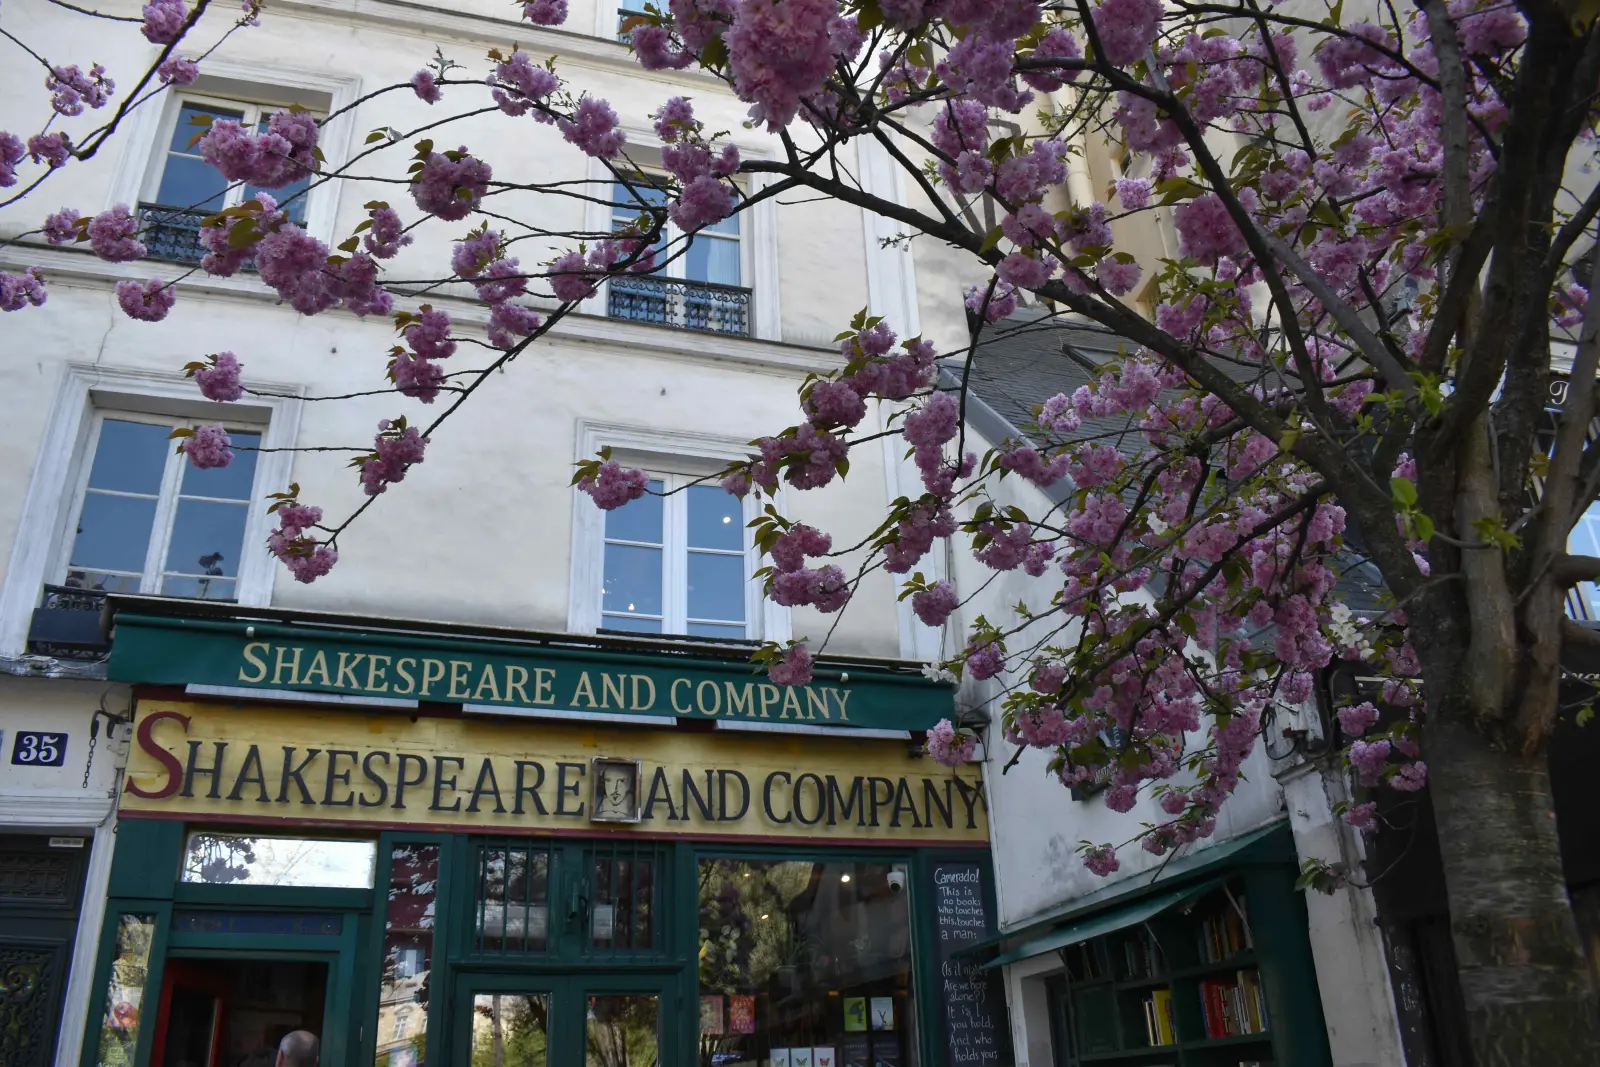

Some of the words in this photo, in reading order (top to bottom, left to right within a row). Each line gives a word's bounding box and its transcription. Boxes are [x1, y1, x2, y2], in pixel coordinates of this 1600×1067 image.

[239, 642, 557, 706] SHAKESPEARE
[570, 671, 657, 712] AND
[670, 677, 852, 721] COMPANY
[19, 735, 59, 763] 35
[126, 711, 586, 818] SHAKESPEARE
[642, 766, 750, 824] AND
[764, 770, 985, 829] COMPANY
[934, 868, 980, 885] Camerado!
[939, 886, 960, 897] This
[964, 886, 973, 896] is
[943, 898, 954, 906] no
[956, 906, 984, 917] touches
[957, 917, 986, 928] touches
[941, 930, 949, 941] a
[941, 960, 951, 977] (Is
[944, 979, 958, 991] Are
[947, 1005, 955, 1018] It
[961, 1005, 971, 1016] is
[950, 1021, 968, 1034] you
[949, 1033, 970, 1047] And
[974, 1031, 992, 1045] who
[954, 1047, 979, 1063] holds
